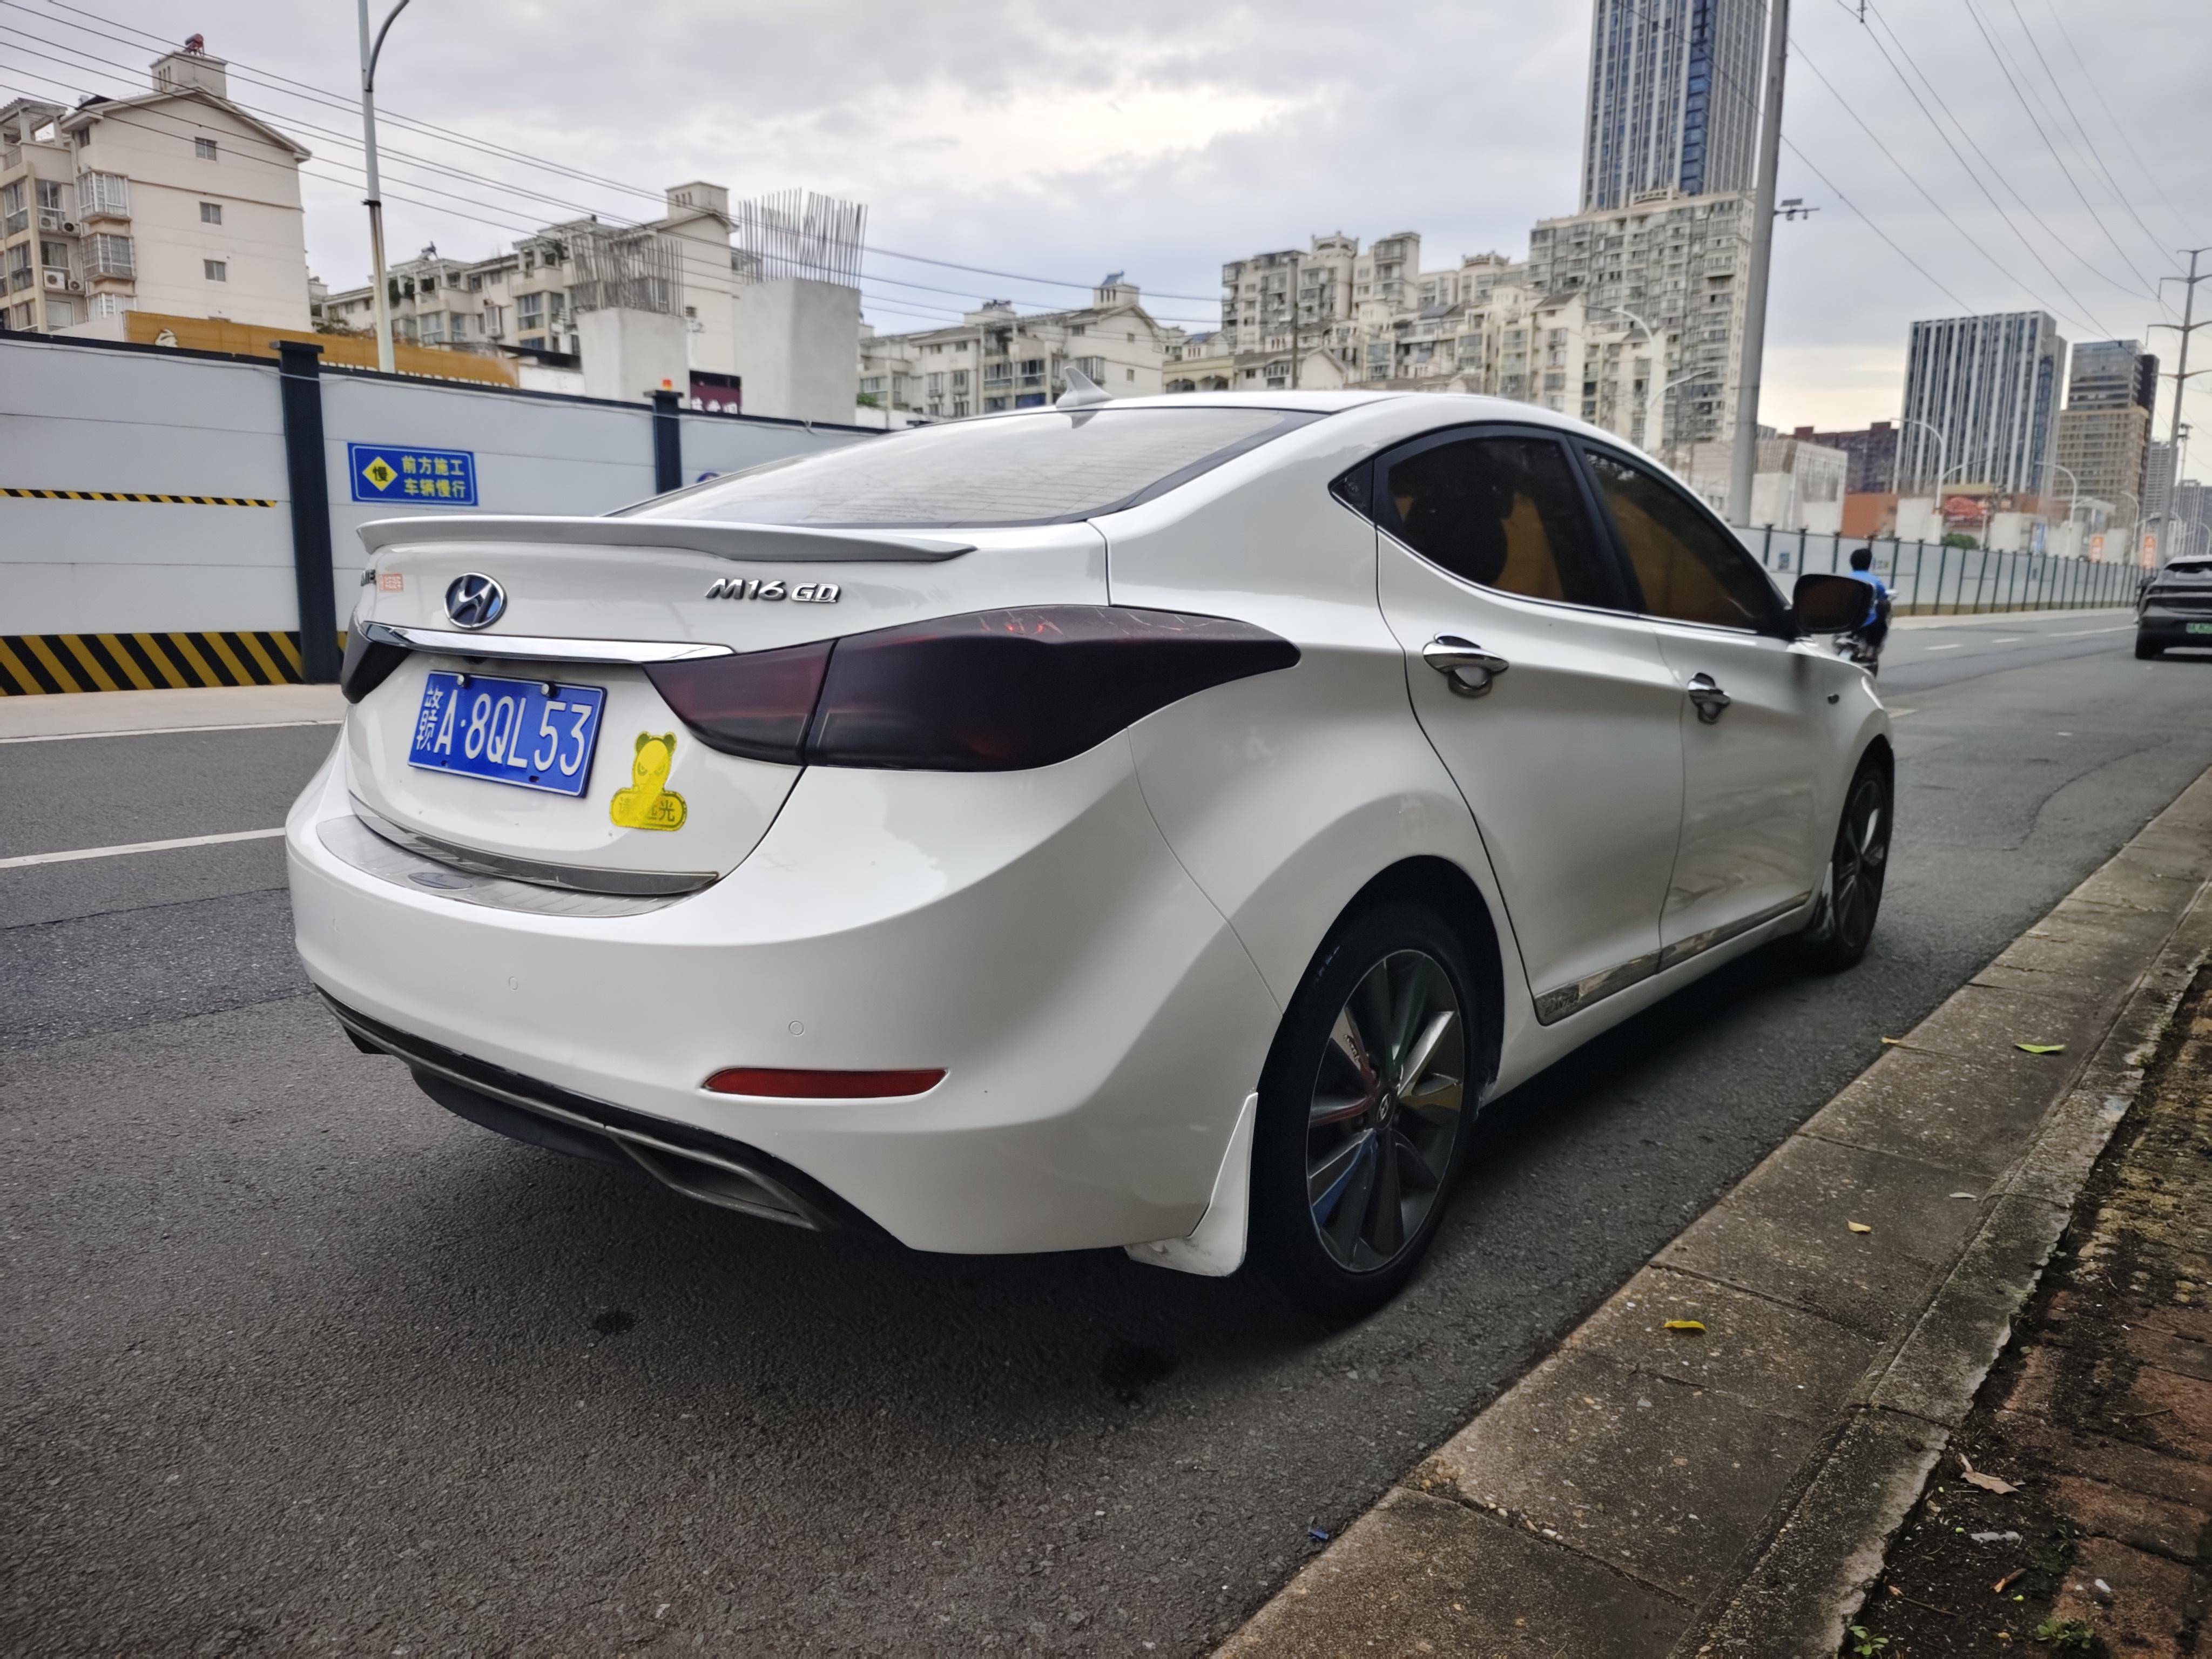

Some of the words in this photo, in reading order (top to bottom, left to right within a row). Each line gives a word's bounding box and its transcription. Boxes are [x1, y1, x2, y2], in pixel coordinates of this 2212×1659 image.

[372, 466, 388, 482] 慢
[401, 455, 464, 476] 前方施工
[404, 478, 466, 498] 车辆慢行
[705, 578, 787, 601] M16
[791, 583, 841, 603] GD
